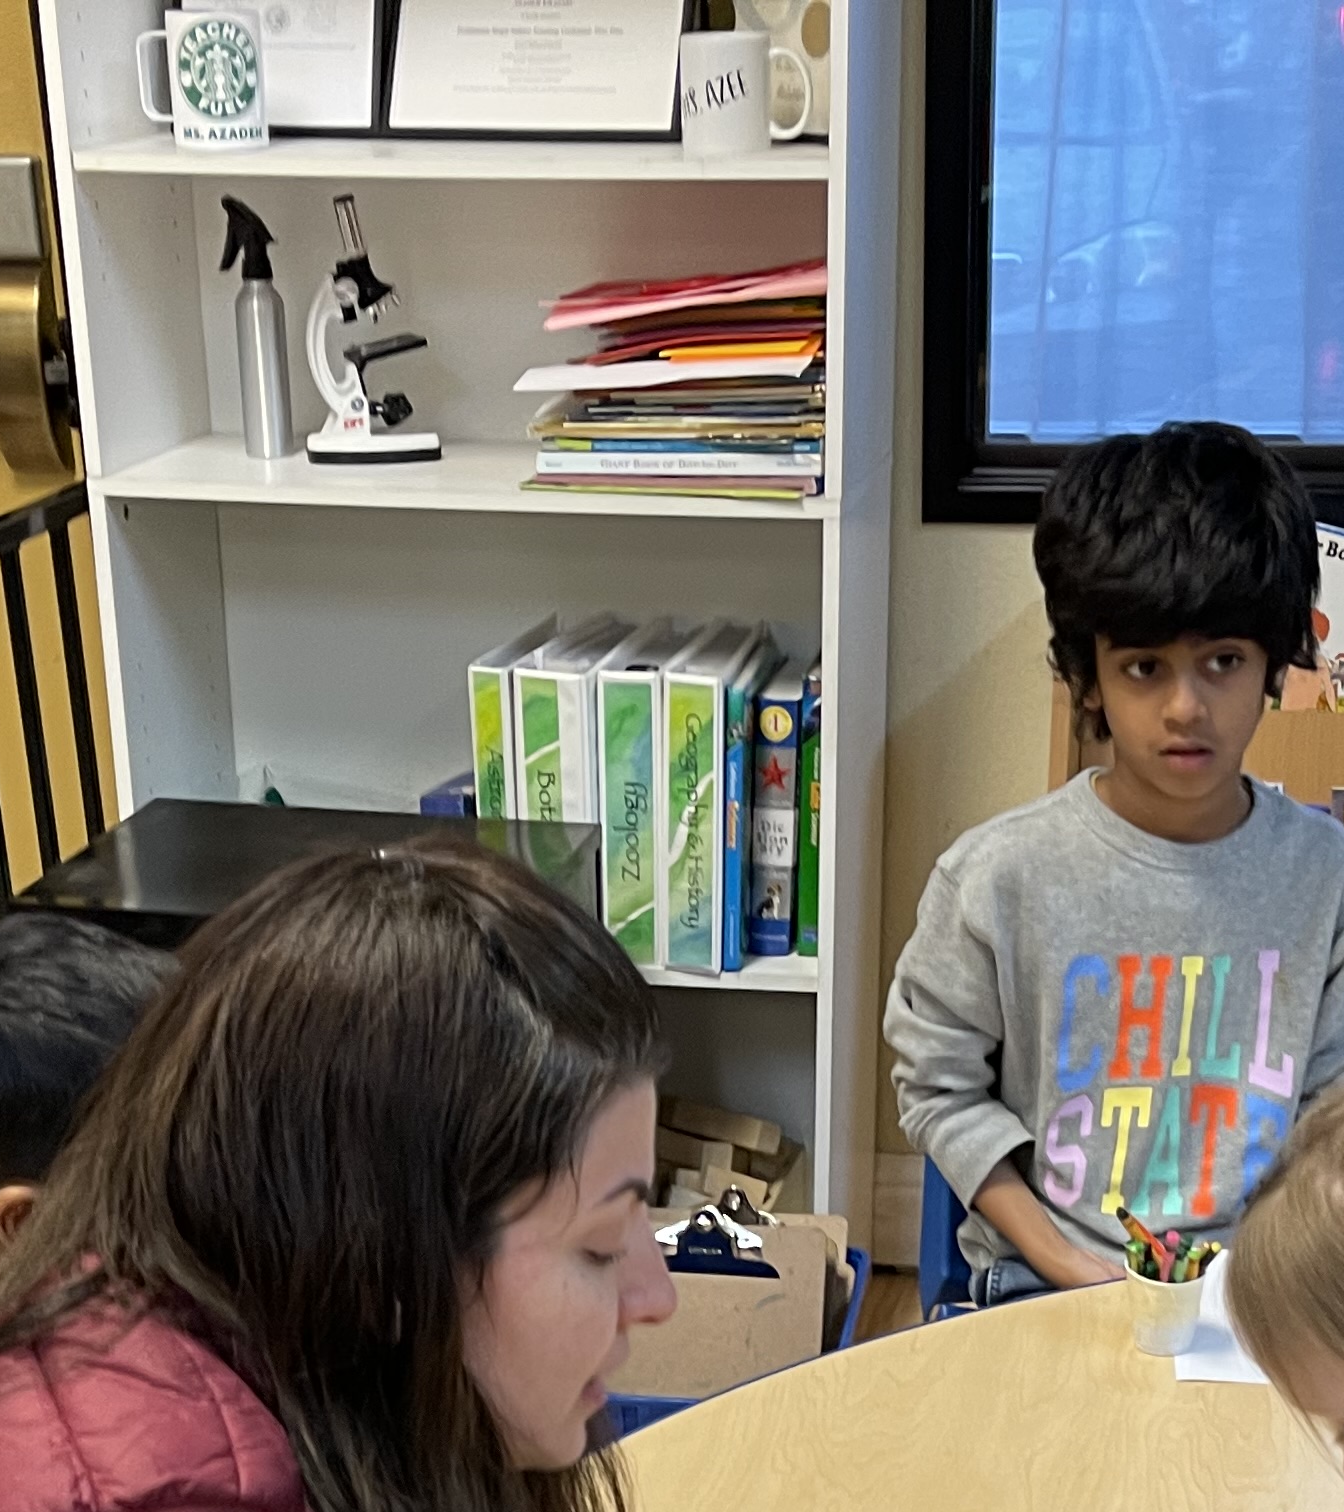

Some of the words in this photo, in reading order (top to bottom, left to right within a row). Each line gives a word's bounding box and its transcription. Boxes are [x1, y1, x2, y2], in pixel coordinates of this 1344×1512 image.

[179, 20, 255, 62] TEACHER
[197, 95, 248, 116] FUEL
[679, 712, 709, 831] Geography
[613, 781, 648, 882] Zoology
[1056, 949, 1294, 1099] CHILL
[1043, 1083, 1289, 1218] STATE
